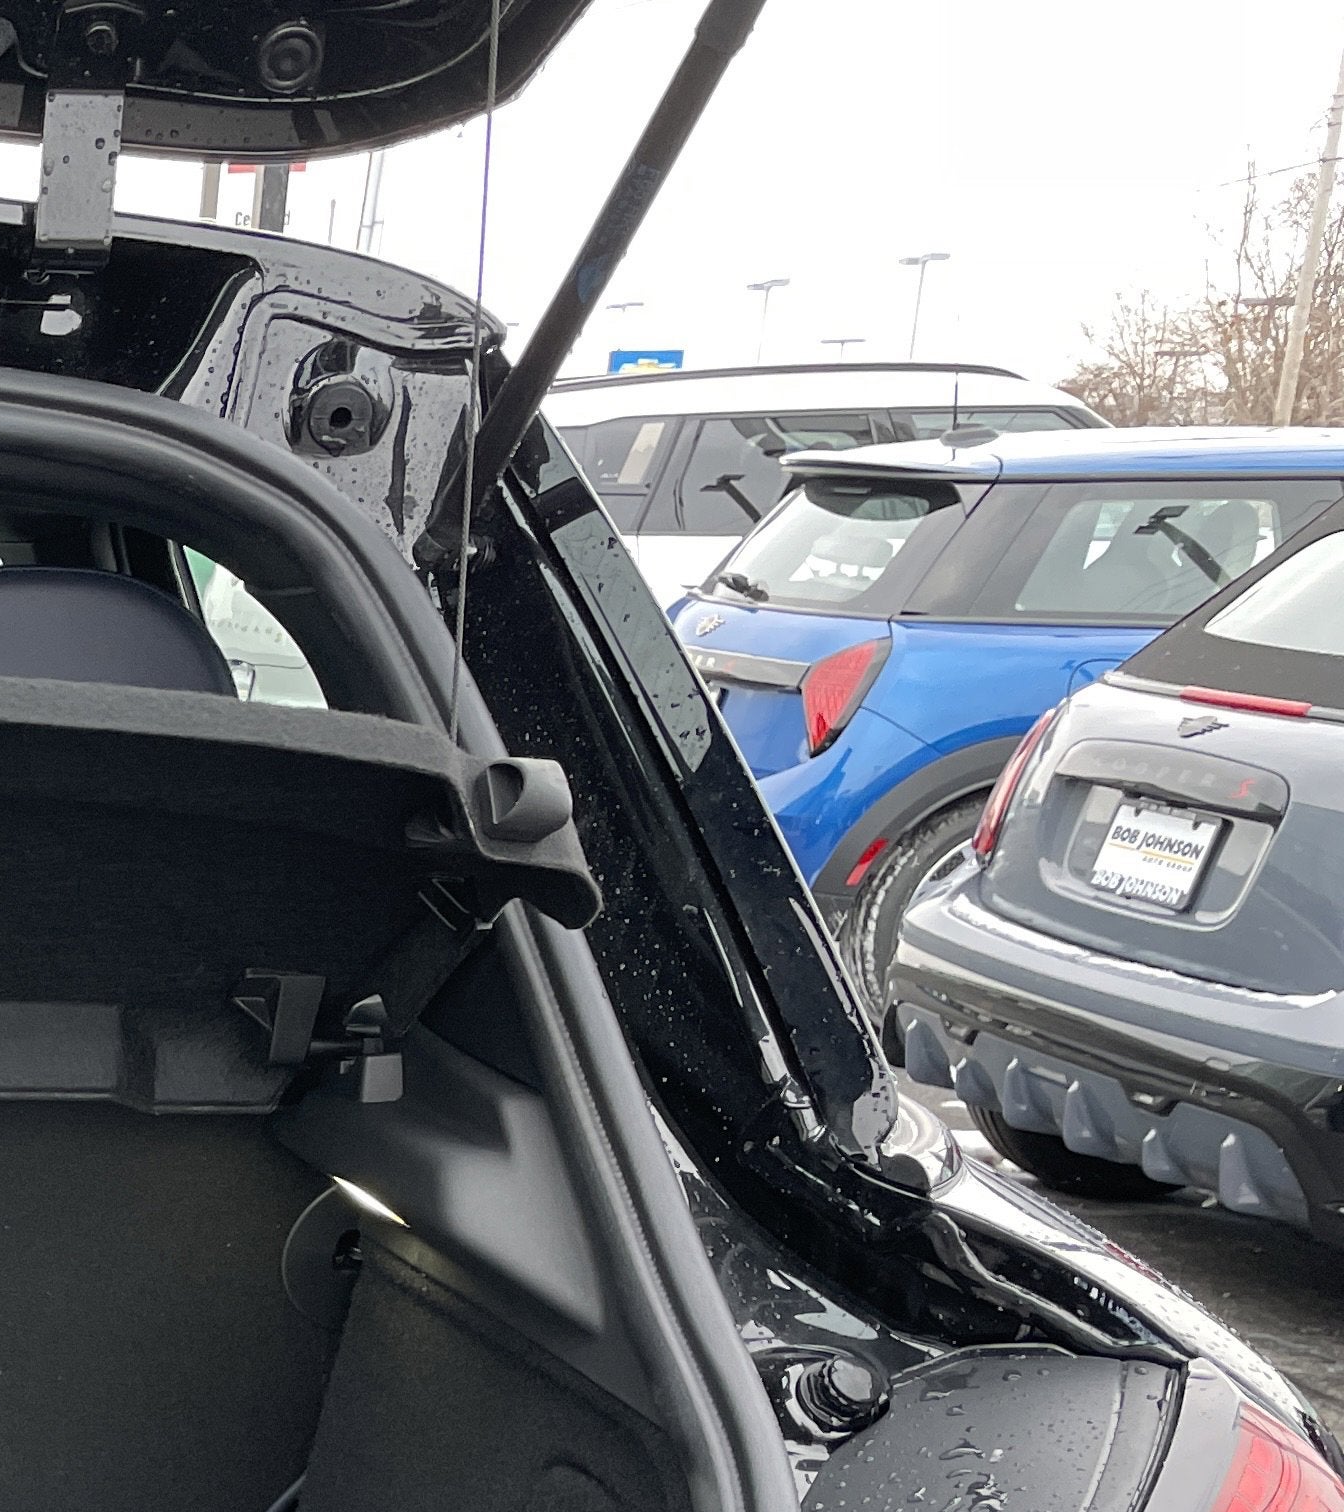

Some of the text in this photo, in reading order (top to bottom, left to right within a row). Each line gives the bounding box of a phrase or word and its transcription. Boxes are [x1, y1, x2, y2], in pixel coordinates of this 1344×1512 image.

[1111, 825, 1205, 861] BOB JOHNSON
[1090, 869, 1183, 905] BOB JOHNSON
